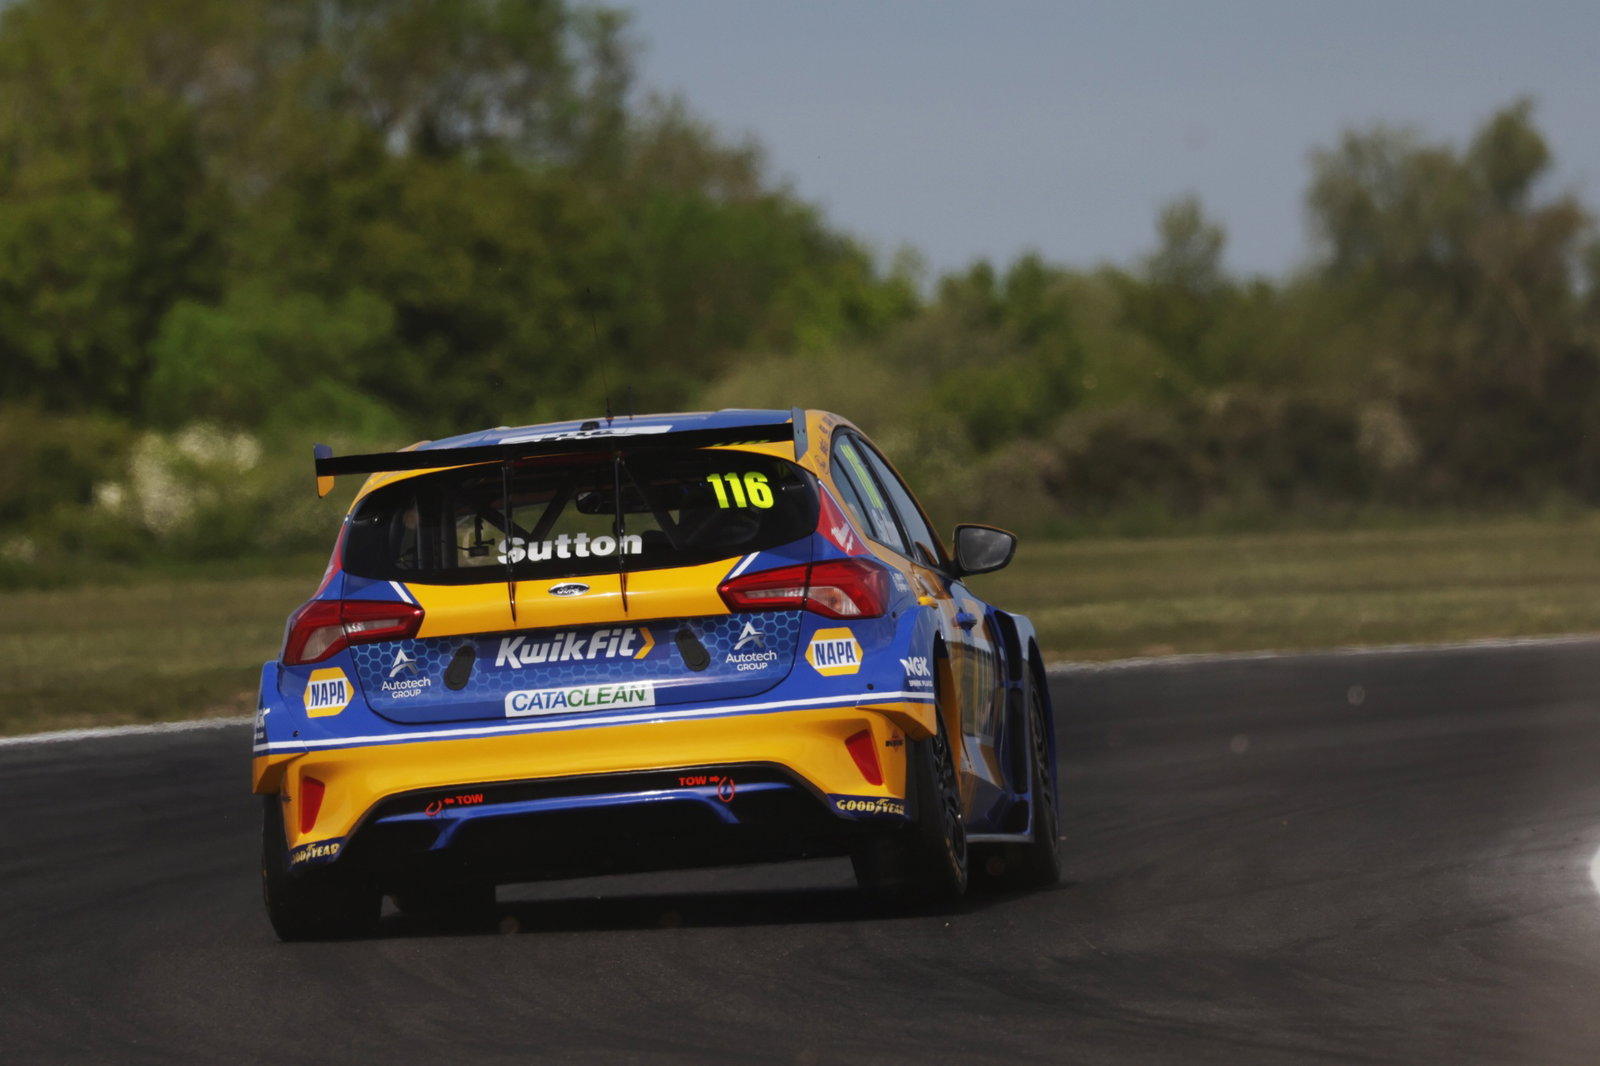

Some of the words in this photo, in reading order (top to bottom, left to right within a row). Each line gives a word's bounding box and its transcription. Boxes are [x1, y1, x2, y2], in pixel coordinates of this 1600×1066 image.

[707, 472, 774, 509] 116
[497, 532, 643, 565] Sutton
[725, 650, 777, 664] Autotech
[814, 641, 856, 666] NAPA
[737, 662, 768, 672] GROUP
[900, 656, 931, 677] NGK
[310, 680, 346, 707] NAPA
[381, 677, 431, 692] Autotech
[391, 689, 422, 699] GROUP
[511, 684, 646, 712] CATACLEAN
[679, 776, 707, 786] TOW
[456, 793, 484, 805] TOW
